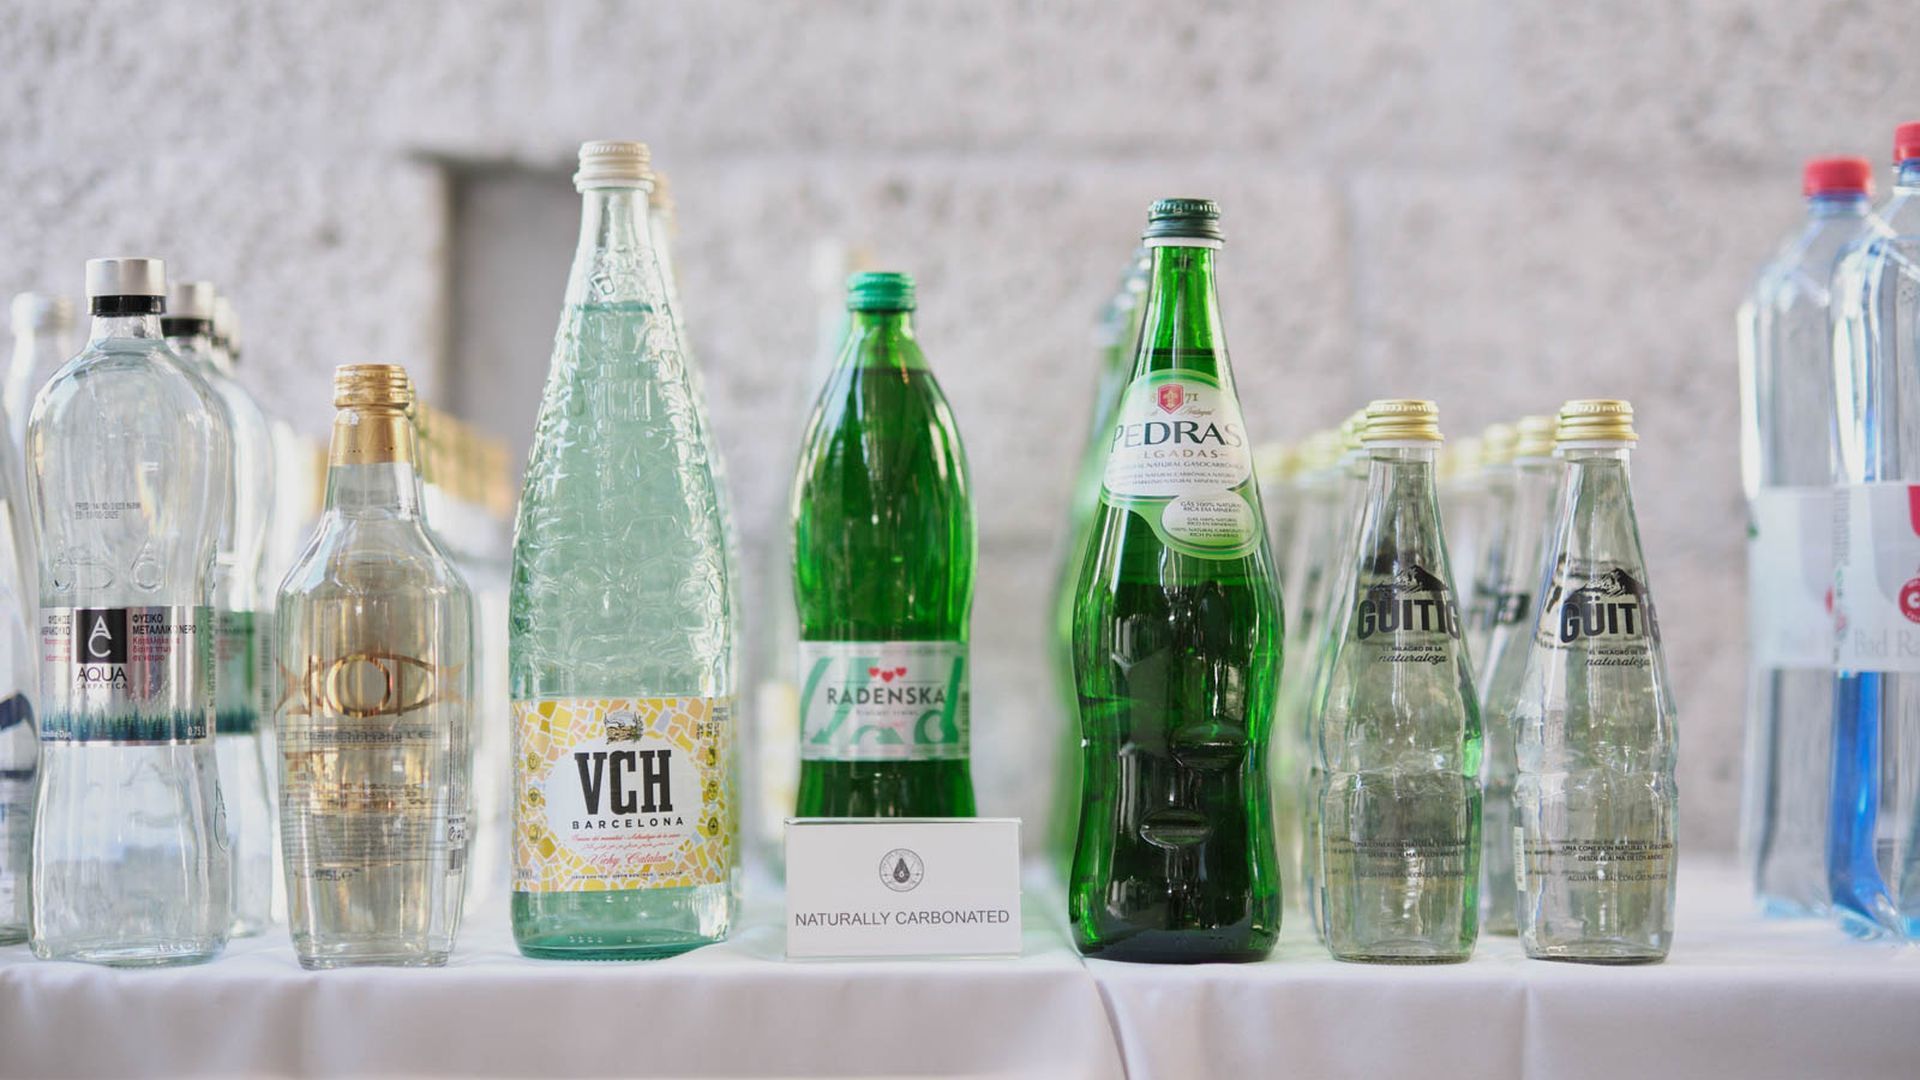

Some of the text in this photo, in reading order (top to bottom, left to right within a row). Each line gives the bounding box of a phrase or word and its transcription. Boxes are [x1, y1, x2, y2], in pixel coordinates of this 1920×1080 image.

[1111, 420, 1243, 453] PEDRAS
[1378, 652, 1448, 666] naturaleza
[77, 666, 128, 682] AQUA
[827, 687, 946, 705] RADENSKA
[573, 749, 674, 816] VCH
[571, 817, 684, 830] BARCELONA
[1588, 874, 1618, 882] MINRAL
[795, 910, 1010, 927] NATURALLY CARBONATED
